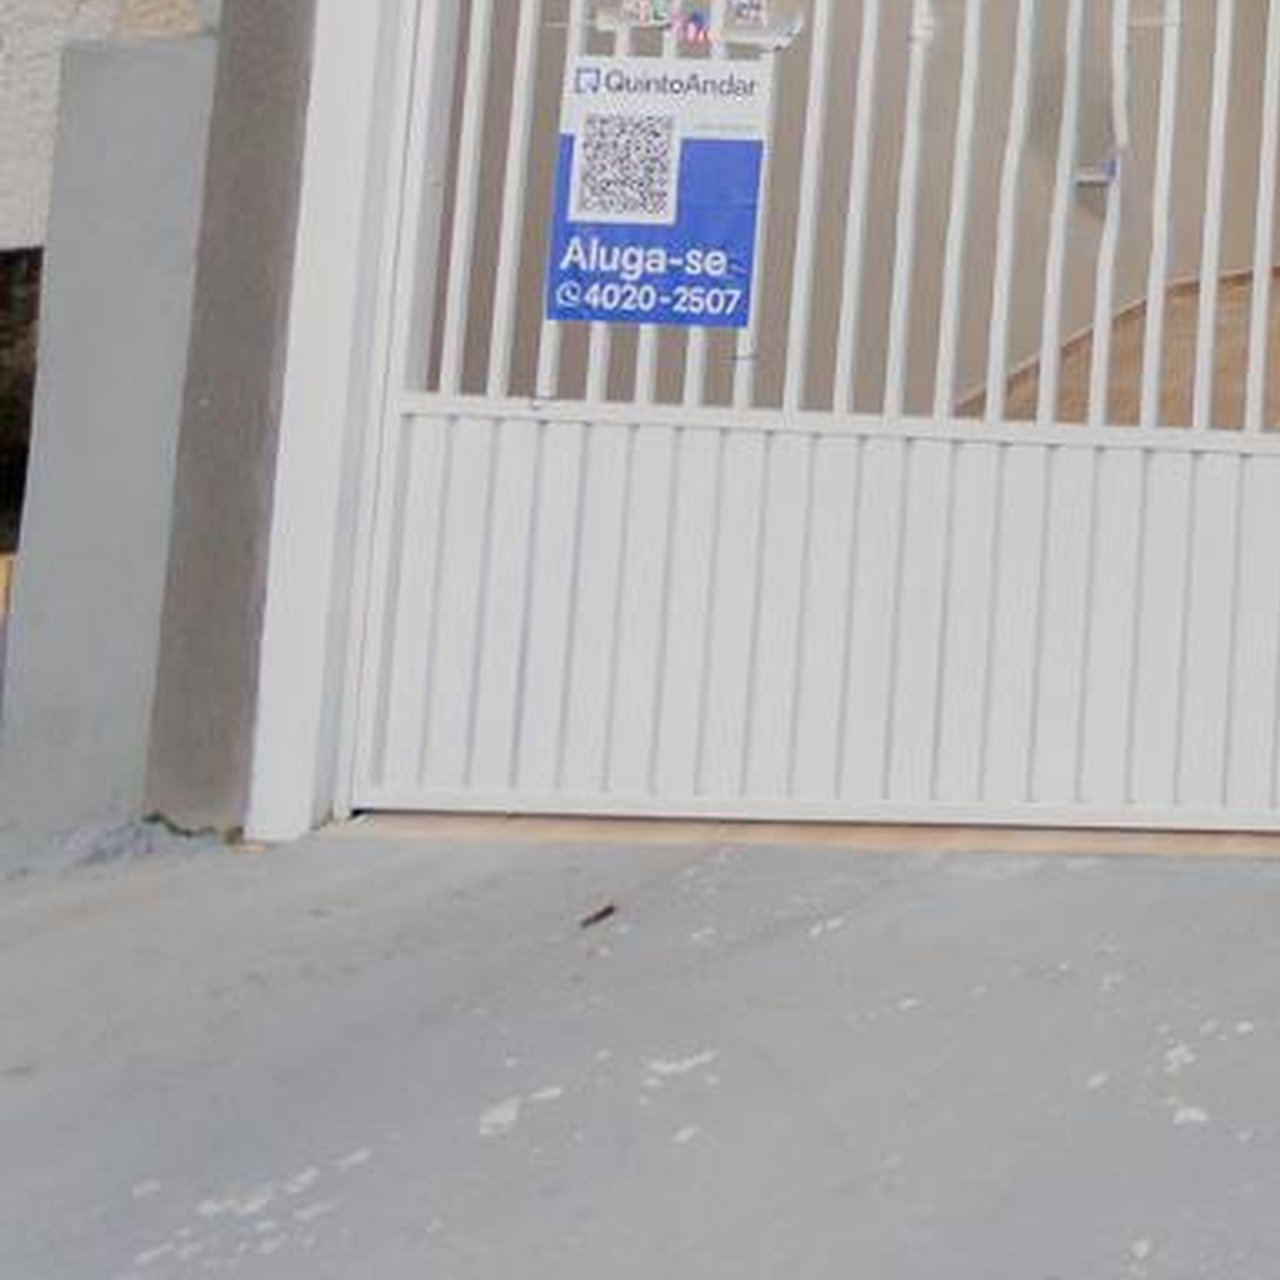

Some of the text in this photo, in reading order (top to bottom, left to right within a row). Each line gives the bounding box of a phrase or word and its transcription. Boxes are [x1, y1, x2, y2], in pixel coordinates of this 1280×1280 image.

[604, 69, 756, 96] QuintoAndar
[559, 236, 727, 281] Aluga-se
[583, 282, 742, 316] 4020-2507
